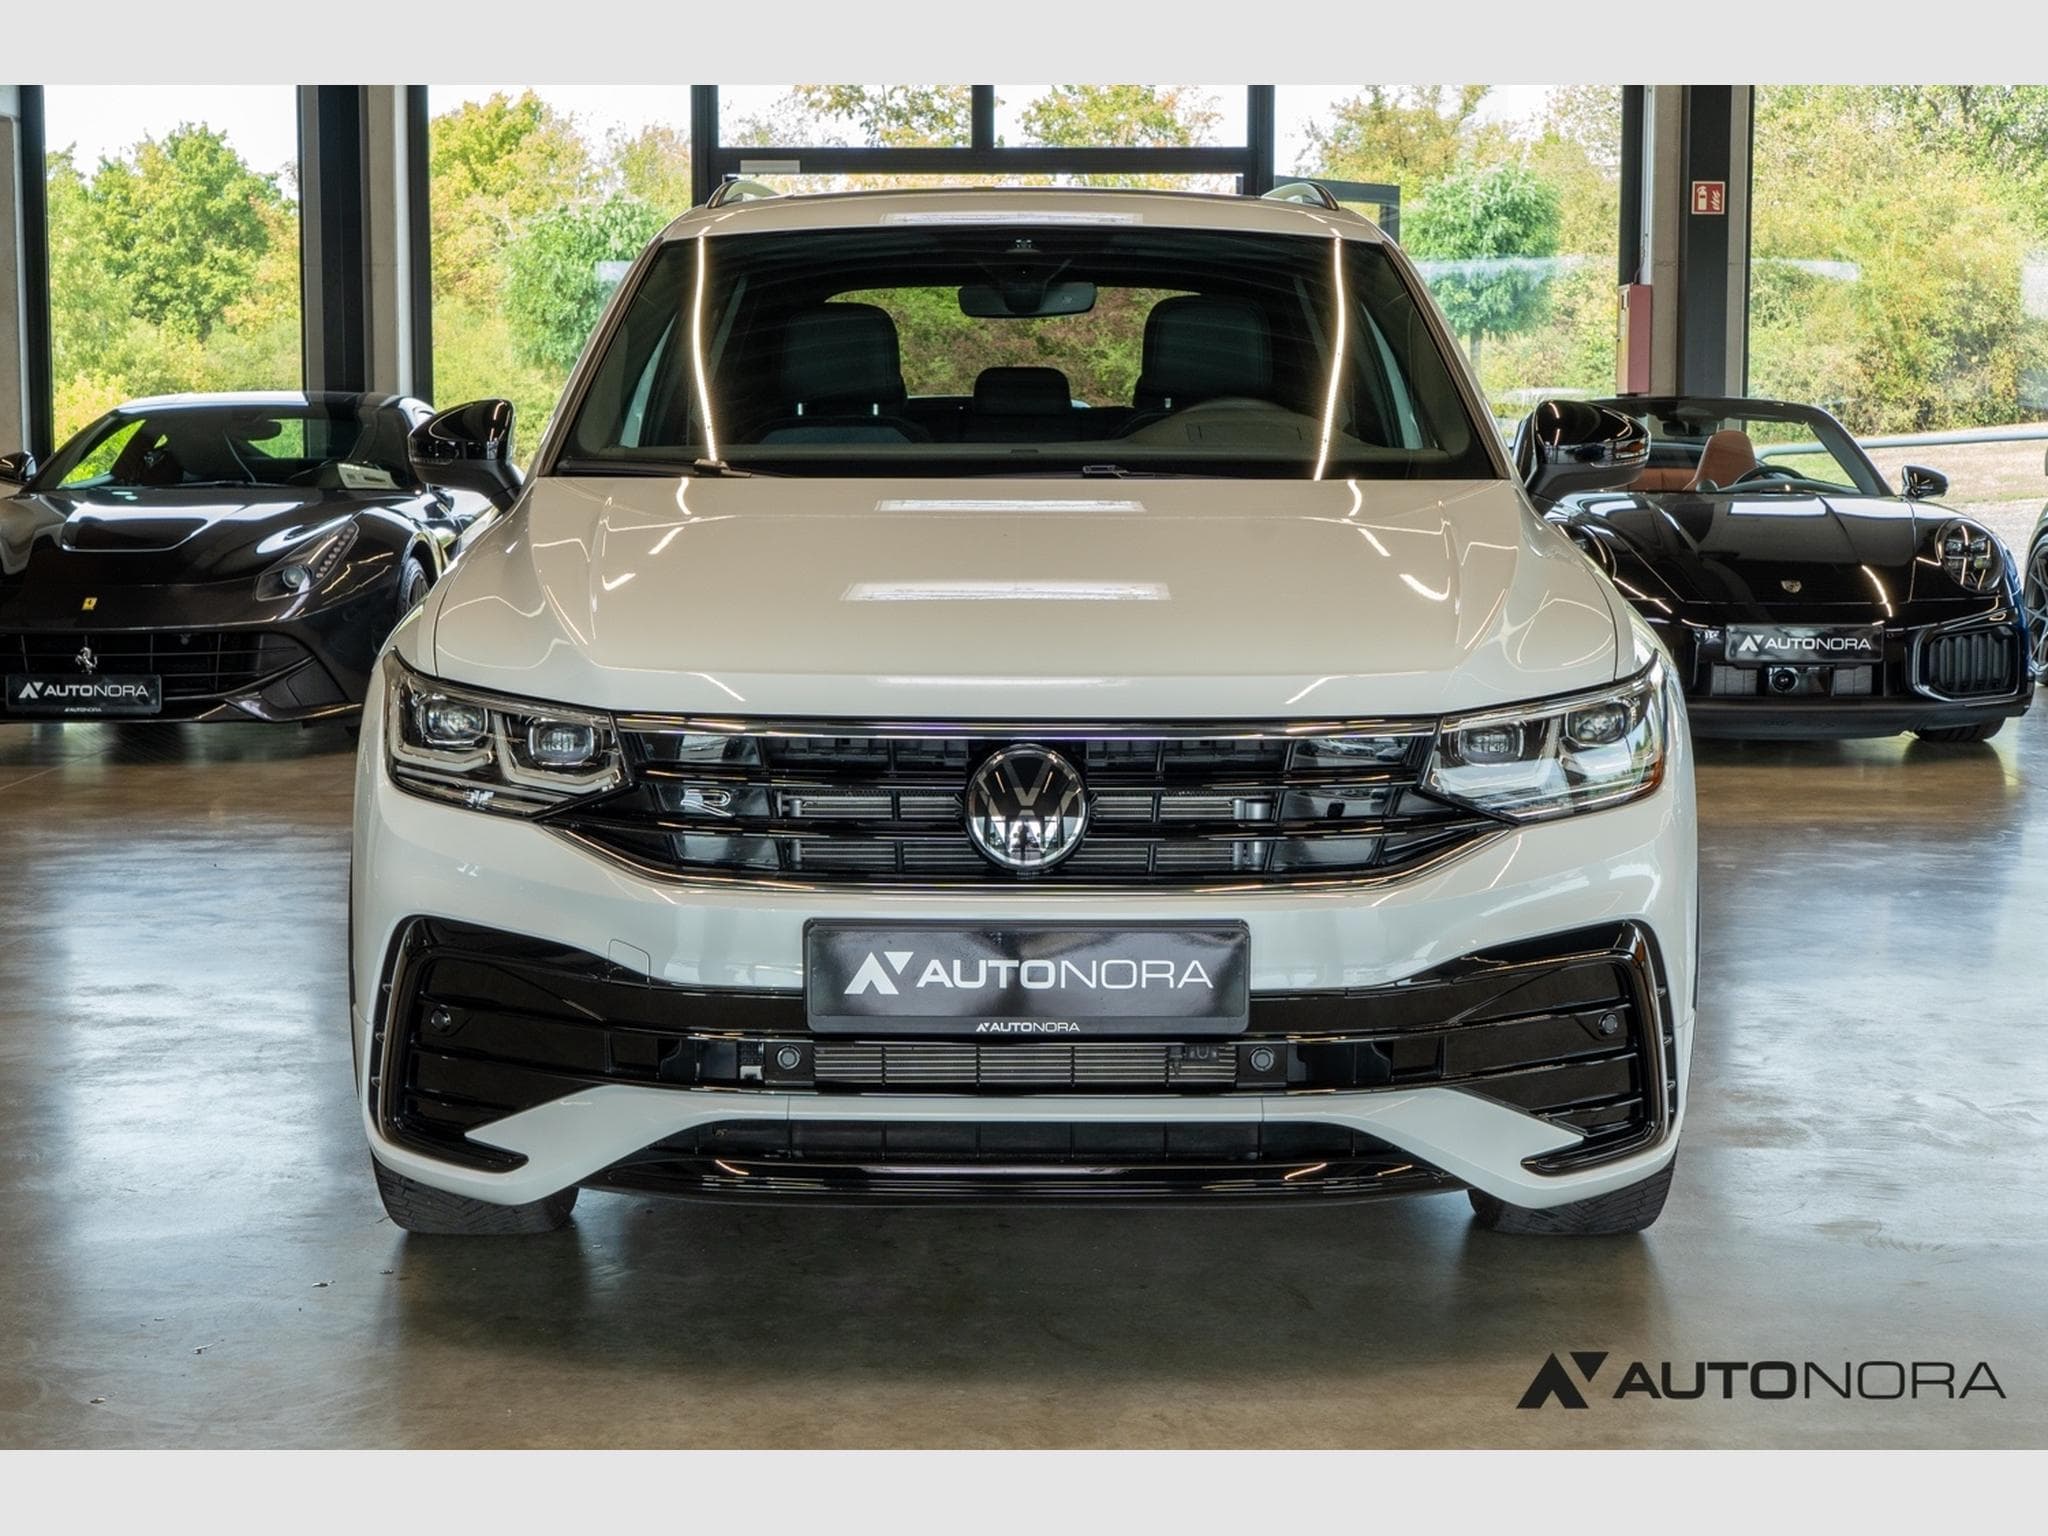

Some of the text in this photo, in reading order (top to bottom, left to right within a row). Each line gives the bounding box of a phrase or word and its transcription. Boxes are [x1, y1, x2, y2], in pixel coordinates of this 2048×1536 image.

[1764, 637, 1872, 651] AUTONORA
[43, 684, 149, 697] AUTONORA
[915, 959, 1214, 990] AUTONORA
[990, 1022, 1080, 1033] AUTONORA
